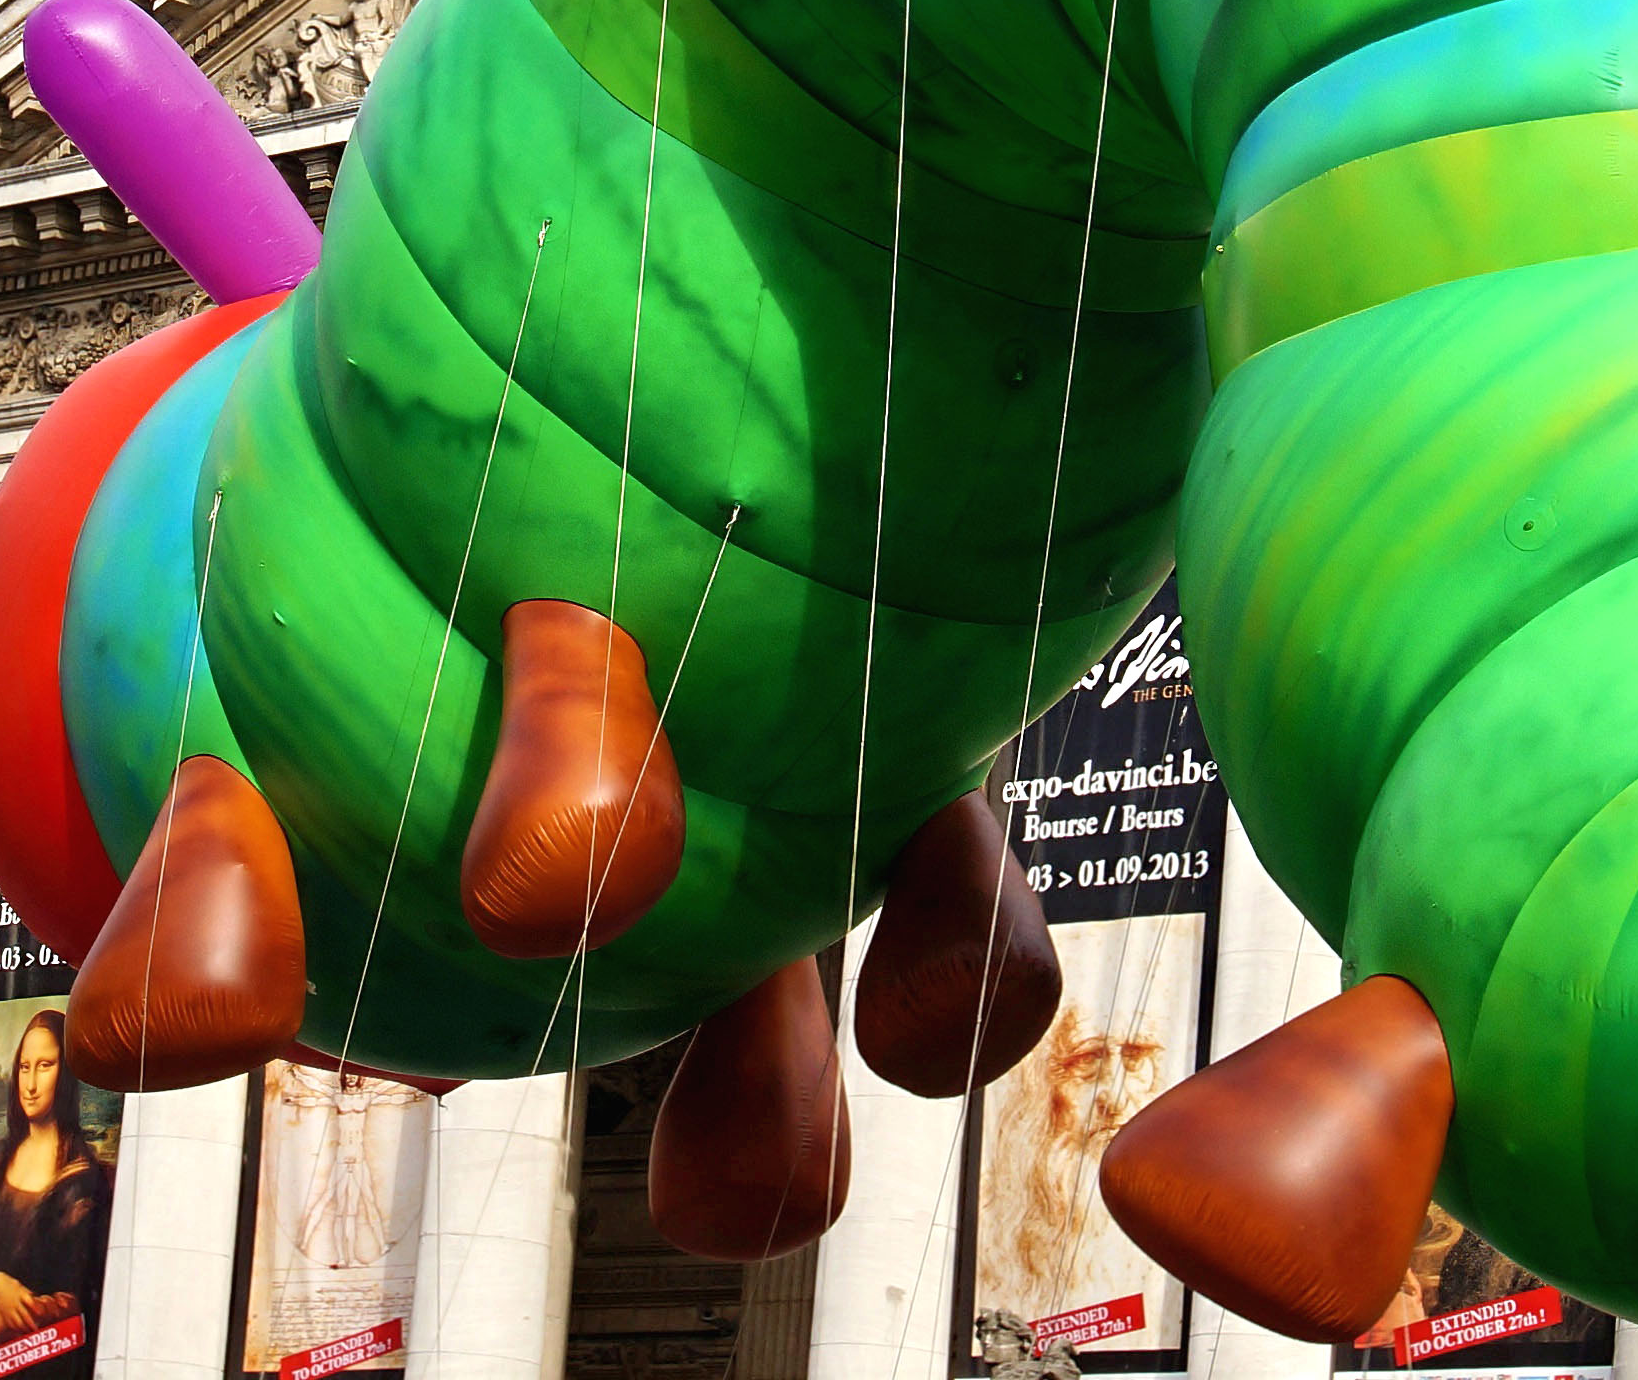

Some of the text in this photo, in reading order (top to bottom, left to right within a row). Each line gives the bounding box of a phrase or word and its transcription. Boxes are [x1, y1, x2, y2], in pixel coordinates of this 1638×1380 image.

[1132, 687, 1159, 703] THE
[1002, 748, 1218, 812] expo-davinci.be
[1022, 804, 1185, 842] Bourse / Beurs
[1078, 850, 1210, 887] 01.09.2013
[1036, 1307, 1109, 1337] EXTENDED
[1101, 1318, 1126, 1336] 27th
[1411, 1340, 1432, 1357] TO
[1433, 1320, 1507, 1352] OCTOBER
[1508, 1311, 1538, 1331] 27th
[1431, 1299, 1517, 1335] EXTENDED
[291, 1367, 310, 1380] TO
[310, 1348, 365, 1377] OCTOBER
[310, 1331, 374, 1363] EXTENDED
